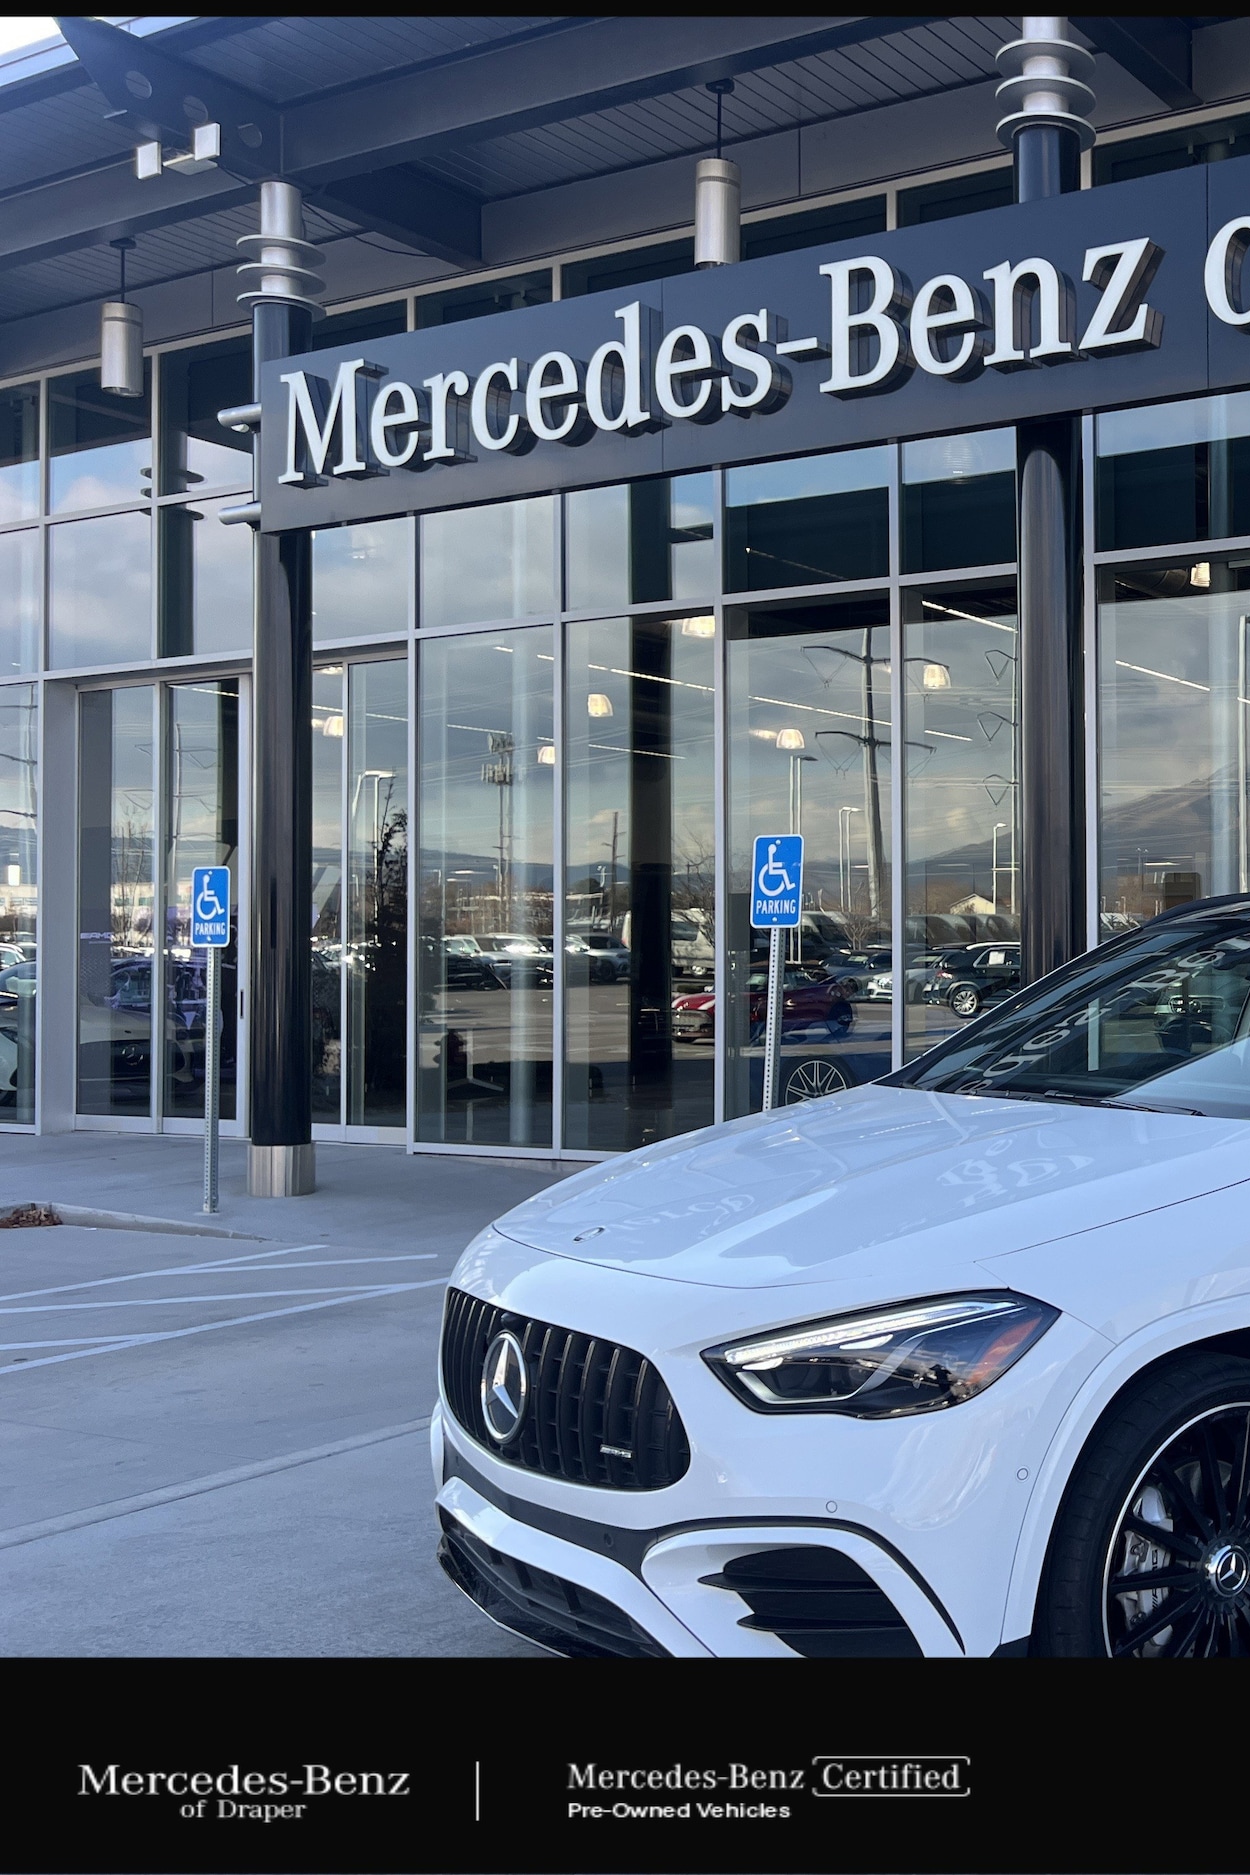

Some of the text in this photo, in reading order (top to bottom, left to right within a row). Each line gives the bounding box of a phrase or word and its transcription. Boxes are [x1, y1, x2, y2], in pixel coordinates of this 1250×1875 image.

[277, 236, 1156, 488] Mercedes-Benz
[755, 899, 797, 914] PARKING
[195, 922, 226, 936] PARKING
